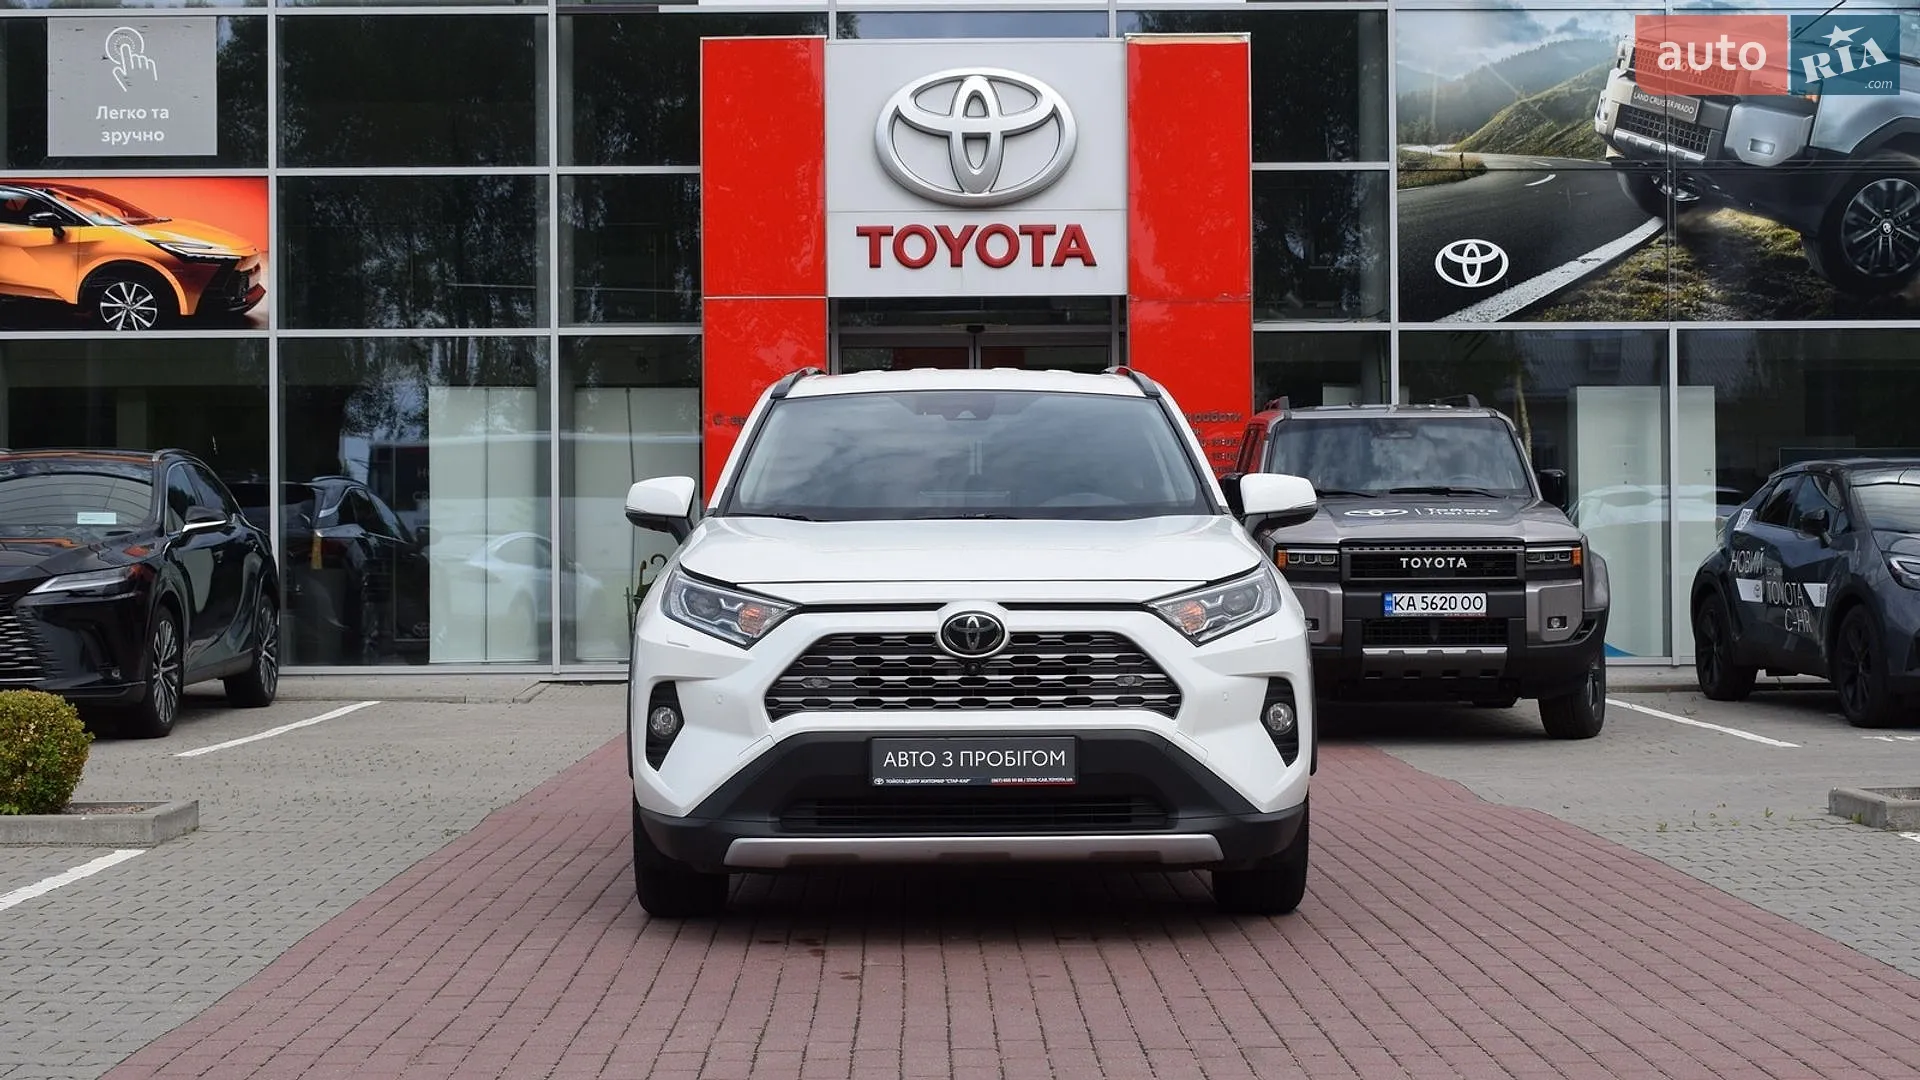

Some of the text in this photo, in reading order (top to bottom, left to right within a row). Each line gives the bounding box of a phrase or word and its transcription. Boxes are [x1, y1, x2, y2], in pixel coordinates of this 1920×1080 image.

[1633, 91, 1649, 102] LAND
[1674, 103, 1695, 114] PRADO
[96, 105, 169, 120] Легко та
[101, 130, 165, 145] зручно
[856, 223, 1098, 269] TOYOTA
[1400, 556, 1467, 569] TOYOTA
[1766, 580, 1805, 606] TOYOTA
[1394, 596, 1417, 611] KA
[1420, 596, 1457, 611] 5620
[1784, 608, 1813, 633] C-HR
[883, 750, 936, 767] АВТО
[960, 750, 1065, 767] ПРОБІГОМ
